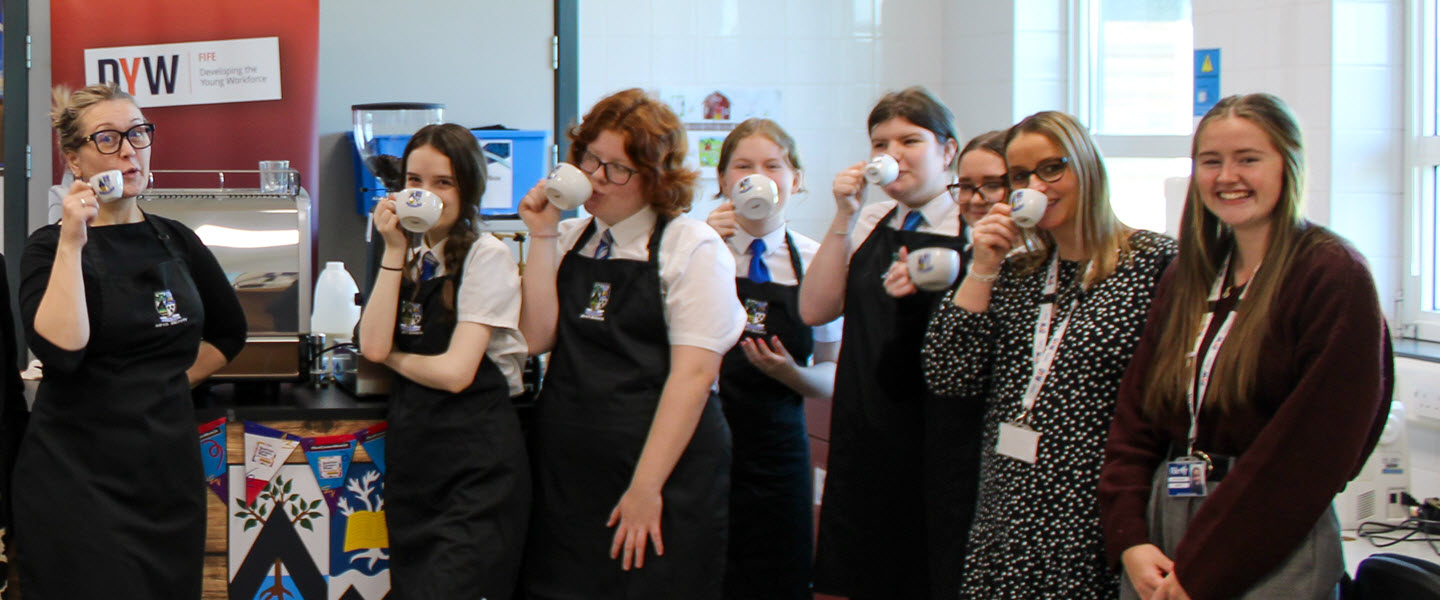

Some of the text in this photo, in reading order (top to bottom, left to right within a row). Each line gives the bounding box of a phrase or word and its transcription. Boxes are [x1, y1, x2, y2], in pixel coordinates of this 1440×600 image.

[198, 52, 217, 62] FIFE
[97, 54, 180, 96] DYW
[199, 65, 259, 78] Developing the
[200, 74, 268, 88] Young Workforce
